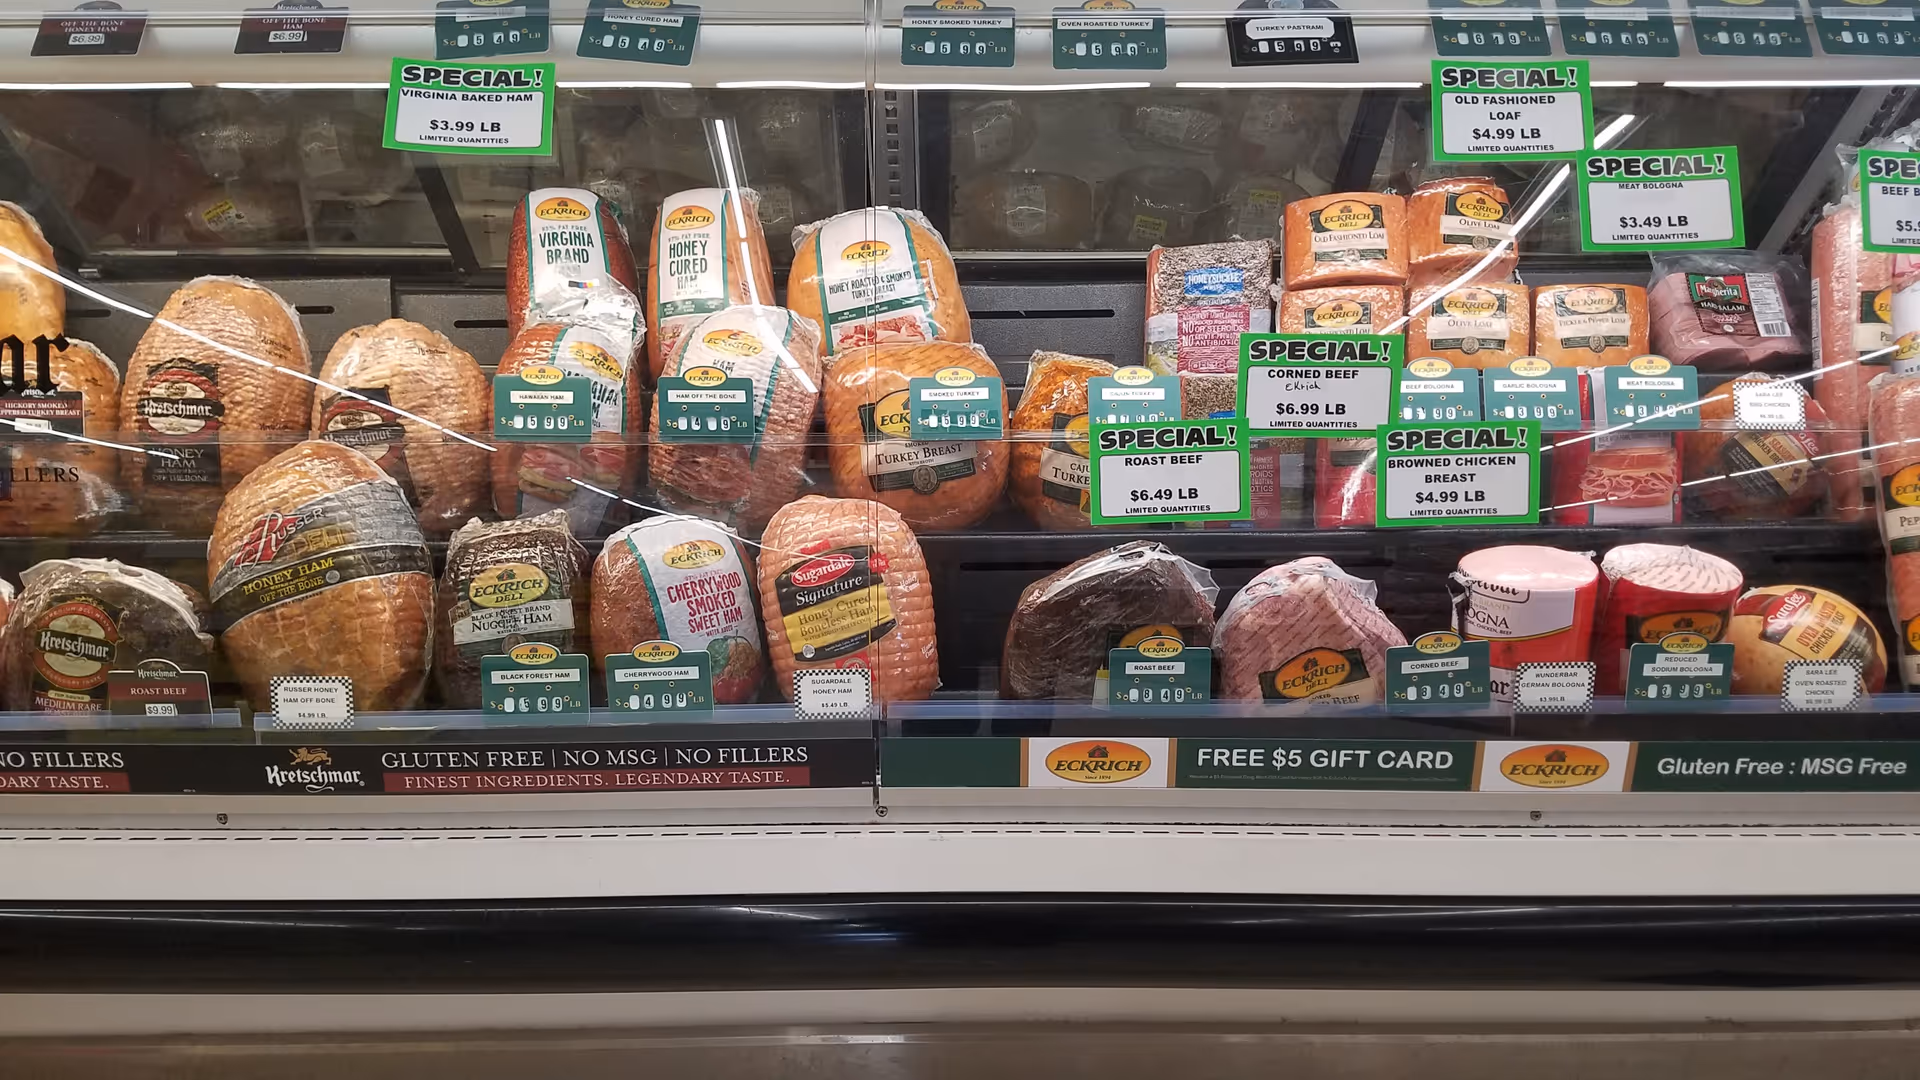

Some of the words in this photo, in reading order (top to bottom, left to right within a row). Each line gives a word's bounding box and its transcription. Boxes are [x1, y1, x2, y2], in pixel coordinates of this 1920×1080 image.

[72, 35, 101, 44] $6.99
[272, 32, 302, 41] $6.99
[402, 66, 544, 88] SPECIAL!
[1441, 67, 1578, 88] SPECIAL!
[400, 88, 458, 102] VIRGINIA
[461, 91, 502, 102] BAKED
[506, 93, 533, 102] HAM
[1455, 96, 1479, 105] OLD
[1483, 96, 1556, 105] FASHIONED
[1489, 112, 1521, 120] LOAF
[429, 119, 475, 132] $3.99
[480, 122, 501, 132] LB
[419, 134, 455, 142] LIMITED
[457, 136, 509, 144] QUANTITIES
[1472, 128, 1515, 140] $4.99
[1520, 128, 1541, 139] LB
[1586, 155, 1726, 177] SPECIAL!
[1882, 186, 1913, 196] BEEF
[540, 208, 587, 217] ECKRICH
[1458, 202, 1501, 215] ECKRICH
[668, 215, 710, 226] ECKRICH
[1323, 212, 1371, 225] ECKRICH
[1459, 218, 1480, 227] OLIVE
[1483, 221, 1501, 230] LOAF
[1619, 216, 1662, 229] $3.49
[1668, 215, 1688, 227] LB
[539, 232, 595, 248] VIRGINIA
[1648, 232, 1699, 240] QUANTITIES
[546, 248, 590, 264] BRAND
[669, 240, 708, 259] HONEY
[846, 248, 889, 260] ECKRICH
[669, 258, 708, 276] CURED
[1700, 284, 1738, 298] Margherita
[1447, 300, 1496, 310] ECKRICH
[1571, 297, 1614, 306] ECKRICH
[1316, 309, 1360, 321] ECKRICH
[1559, 318, 1582, 327] PICKLE
[1588, 316, 1610, 326] PEPPER
[1611, 317, 1626, 326] LOAF
[1447, 318, 1471, 328] OLIVE
[1472, 320, 1493, 328] LOAF
[1249, 340, 1392, 363] SPECIAL!
[1268, 369, 1321, 379] CORNED
[1325, 370, 1359, 379] BEEF
[1276, 403, 1319, 416] $6.99
[1325, 404, 1346, 415] LB
[1099, 425, 1237, 451] SPECIAL!
[1386, 427, 1528, 452] SPECIAL!
[875, 450, 920, 465] TURKEY
[923, 443, 963, 458] BREAST
[1125, 456, 1166, 466] ROAST
[1170, 454, 1203, 465] BEEF
[1388, 458, 1451, 469] BROWNED
[1455, 456, 1516, 466] CHICKEN
[1425, 473, 1476, 484] BREAST
[1130, 488, 1173, 502] $6.49
[1178, 488, 1199, 500] LB
[1415, 491, 1459, 504] $4.99
[1465, 490, 1486, 502] LB
[1160, 505, 1211, 513] QUANTITIES
[671, 550, 722, 565] ECKRICH
[243, 568, 294, 595] HONEY
[298, 557, 335, 576] HAM
[794, 556, 852, 583] Sugardale
[260, 590, 276, 604] OFF
[278, 586, 298, 598] THE
[299, 578, 324, 591] BONE
[473, 579, 544, 598] ECKRICH
[667, 571, 742, 603] CHERRYWOOD
[796, 575, 863, 606] Signature
[495, 593, 524, 603] DELI
[686, 590, 737, 617] SMOKED
[798, 607, 834, 626] Honey
[836, 594, 872, 611] Cured
[688, 613, 721, 634] SWEET
[724, 606, 744, 624] HAM
[800, 615, 848, 636] Boneless
[850, 605, 878, 619] Ham
[40, 631, 110, 659] Kretschmar
[1420, 642, 1457, 650] ECKRICH
[1810, 627, 1835, 654] CHICKEN
[1282, 663, 1346, 691] ECKRICH
[1305, 679, 1328, 692] DELI
[35, 696, 76, 709] MEDIUM
[78, 701, 102, 711] RARE
[148, 706, 174, 715] $9.99
[381, 752, 480, 768] GLUTEN
[486, 751, 544, 767] FREE
[563, 750, 599, 766] NO
[606, 750, 658, 766] MSG
[676, 749, 711, 765] NO
[718, 747, 809, 764] FILLERS
[1197, 749, 1265, 767] FREE
[1272, 747, 1302, 771] $5
[1310, 750, 1371, 768] GIFT
[1377, 750, 1454, 769] CARD
[1054, 760, 1143, 773] ECKRICH
[1507, 764, 1601, 778] ECKRICH
[1657, 757, 1729, 774] Gluten
[1735, 758, 1784, 774] Free
[1800, 758, 1854, 775] MSG
[1858, 758, 1907, 775] Free
[45, 776, 109, 789] TASTE.
[265, 765, 361, 789] Kretschmar
[405, 776, 470, 789] FINEST
[477, 774, 608, 788] INGREDIENTS.
[615, 772, 724, 786] LEGENDARY
[728, 771, 790, 784] TASTE.
